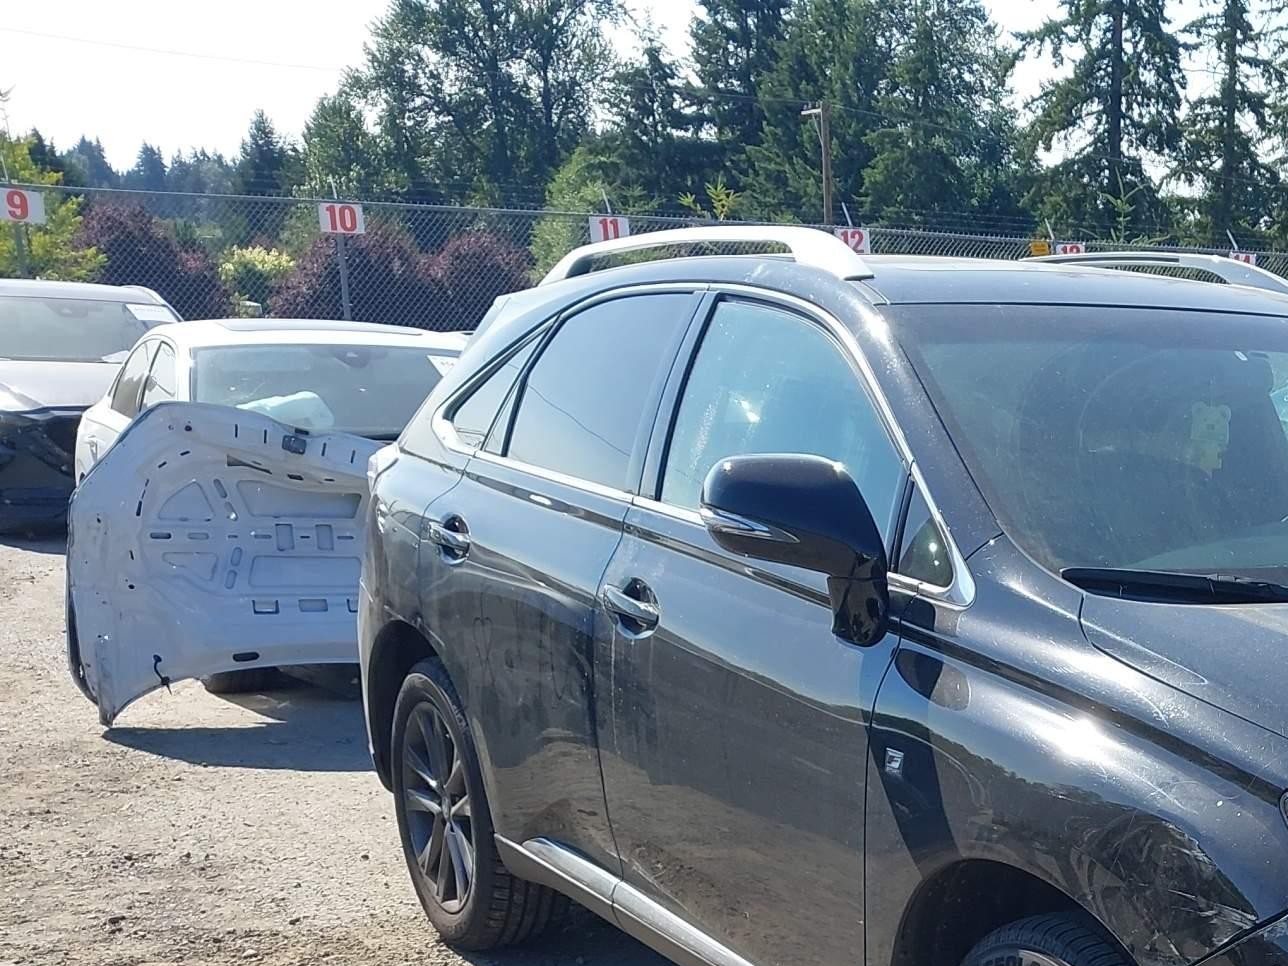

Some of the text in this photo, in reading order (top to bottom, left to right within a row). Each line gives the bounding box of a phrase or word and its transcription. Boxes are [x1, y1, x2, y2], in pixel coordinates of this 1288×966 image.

[6, 190, 29, 219] 9
[325, 204, 358, 232] 10
[599, 218, 620, 241] 11
